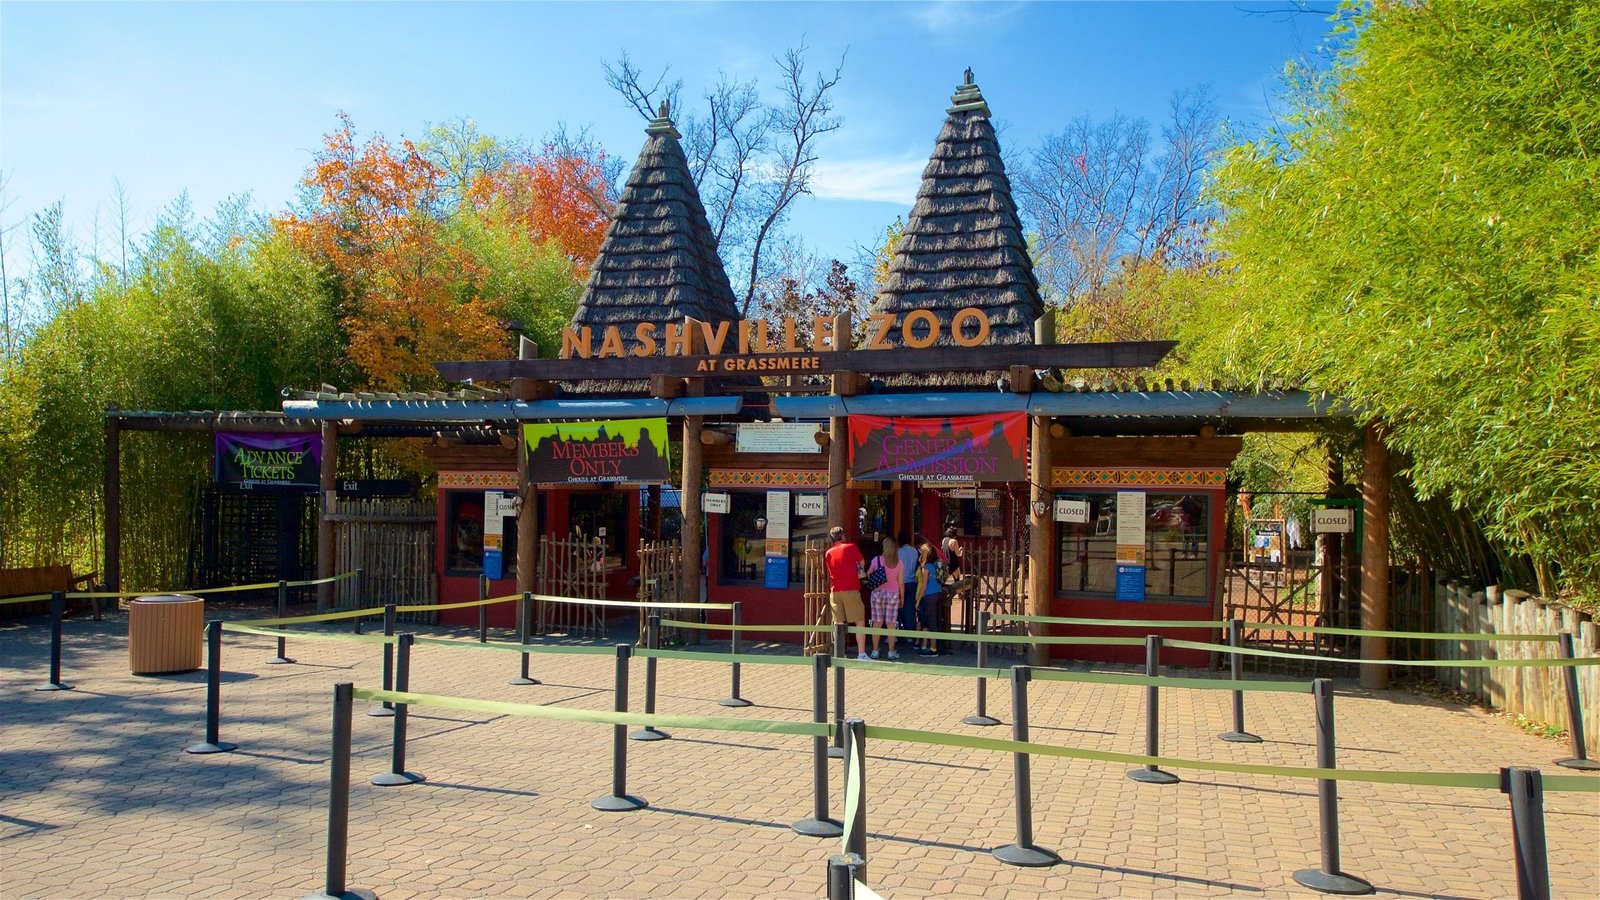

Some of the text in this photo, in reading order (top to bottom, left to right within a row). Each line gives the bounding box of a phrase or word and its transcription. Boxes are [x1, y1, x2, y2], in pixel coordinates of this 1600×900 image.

[562, 307, 990, 359] NASHVILLE ZOO
[696, 356, 821, 372] AT GRASSMERE
[552, 441, 640, 459] MEMBERS
[882, 435, 989, 455] GENERAL
[234, 448, 304, 465] ADVANCE
[876, 455, 998, 474] ADMISSION
[239, 462, 296, 480] TICKETS
[569, 458, 623, 476] ONLY
[936, 473, 974, 481] GRASSMERE
[343, 481, 358, 491] Exit
[1058, 507, 1084, 516] CLOSED
[1317, 517, 1347, 525] CLOSED
